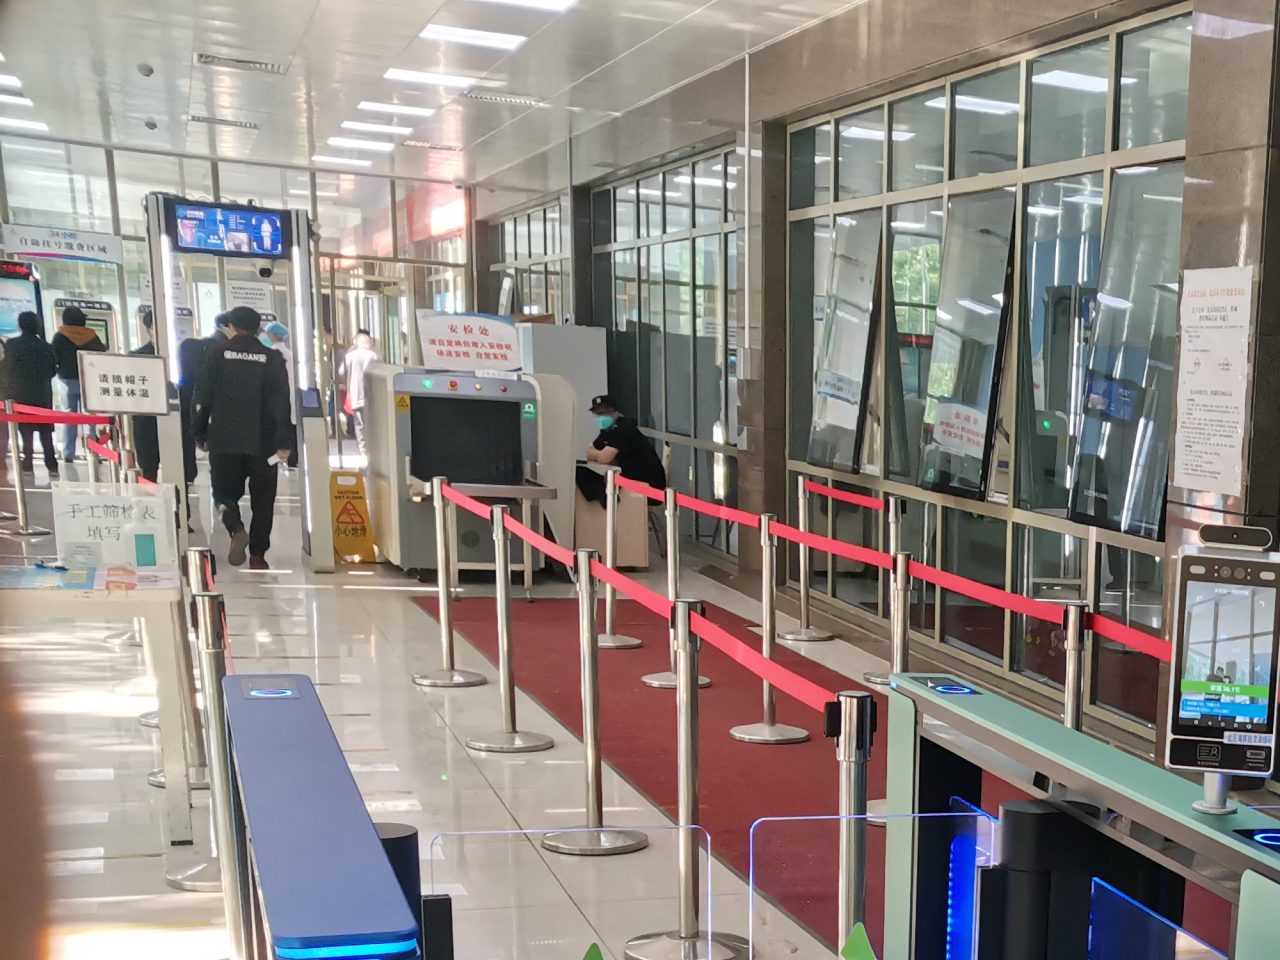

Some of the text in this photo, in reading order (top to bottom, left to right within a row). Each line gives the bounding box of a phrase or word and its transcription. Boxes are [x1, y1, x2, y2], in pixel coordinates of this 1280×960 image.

[98, 373, 149, 385] 请摘帽子
[100, 386, 149, 398] 测量体温
[87, 525, 120, 541] 填写
